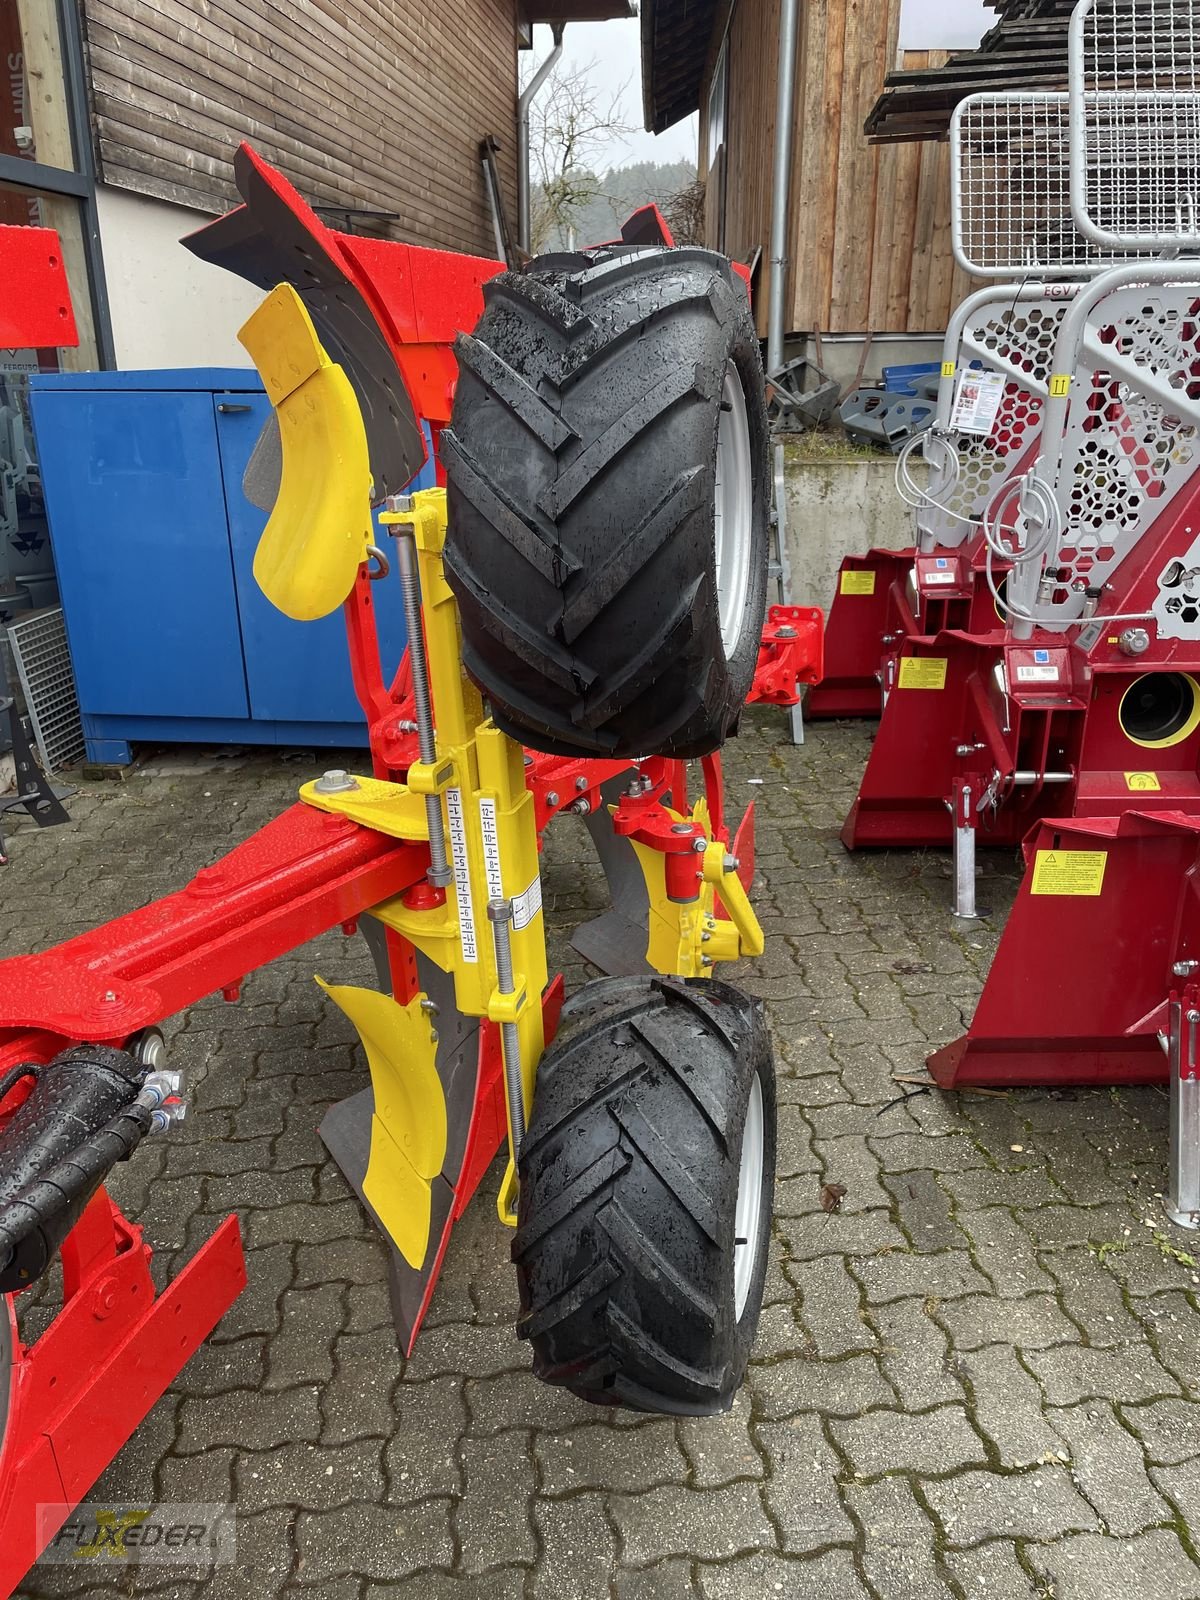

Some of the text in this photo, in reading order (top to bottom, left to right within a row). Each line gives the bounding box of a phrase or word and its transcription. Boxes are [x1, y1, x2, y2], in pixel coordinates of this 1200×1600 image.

[1044, 285, 1071, 297] EGV
[453, 793, 458, 802] 0
[454, 806, 459, 815] 1
[481, 807, 489, 817] 12
[455, 819, 461, 829] 2
[482, 821, 491, 830] 11
[457, 833, 462, 841] 3
[484, 834, 492, 843] 10
[487, 847, 493, 856] 9
[459, 858, 465, 867] 5
[489, 860, 495, 869] 8
[461, 871, 466, 880] 6
[490, 873, 495, 882] 7
[462, 884, 467, 892] 7
[491, 886, 497, 895] 6
[462, 896, 468, 905] 8
[464, 909, 469, 917] 9
[465, 921, 473, 930] 10
[466, 934, 475, 942] 11
[468, 946, 476, 954] 12
